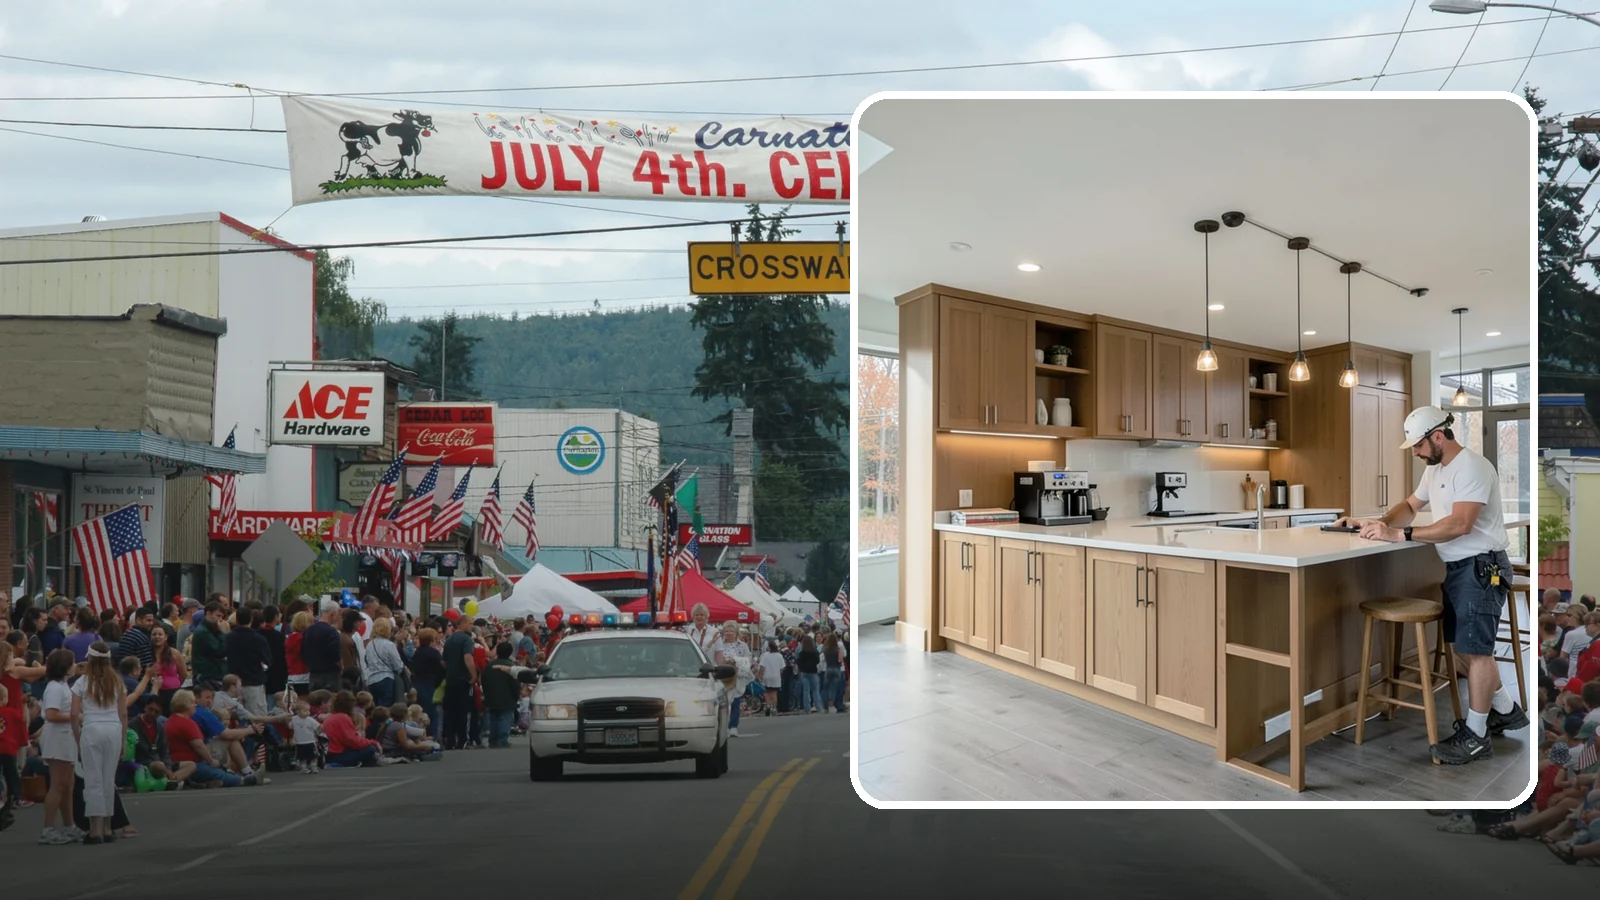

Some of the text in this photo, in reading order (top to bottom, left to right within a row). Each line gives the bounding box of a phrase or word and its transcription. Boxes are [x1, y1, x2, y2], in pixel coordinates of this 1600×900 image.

[481, 140, 605, 191] JULY
[632, 149, 747, 198] 4th.
[696, 253, 850, 281] CROSSWA
[282, 379, 374, 420] ACE
[405, 409, 453, 423] CEDAR
[283, 421, 371, 437] Hardware
[416, 428, 477, 447] Coca-Cola
[353, 467, 384, 481] Simpl
[95, 484, 124, 495] Vincent
[126, 485, 136, 495] de
[137, 485, 155, 496] Paul
[81, 503, 154, 522] THT
[687, 526, 742, 535] CRNATION
